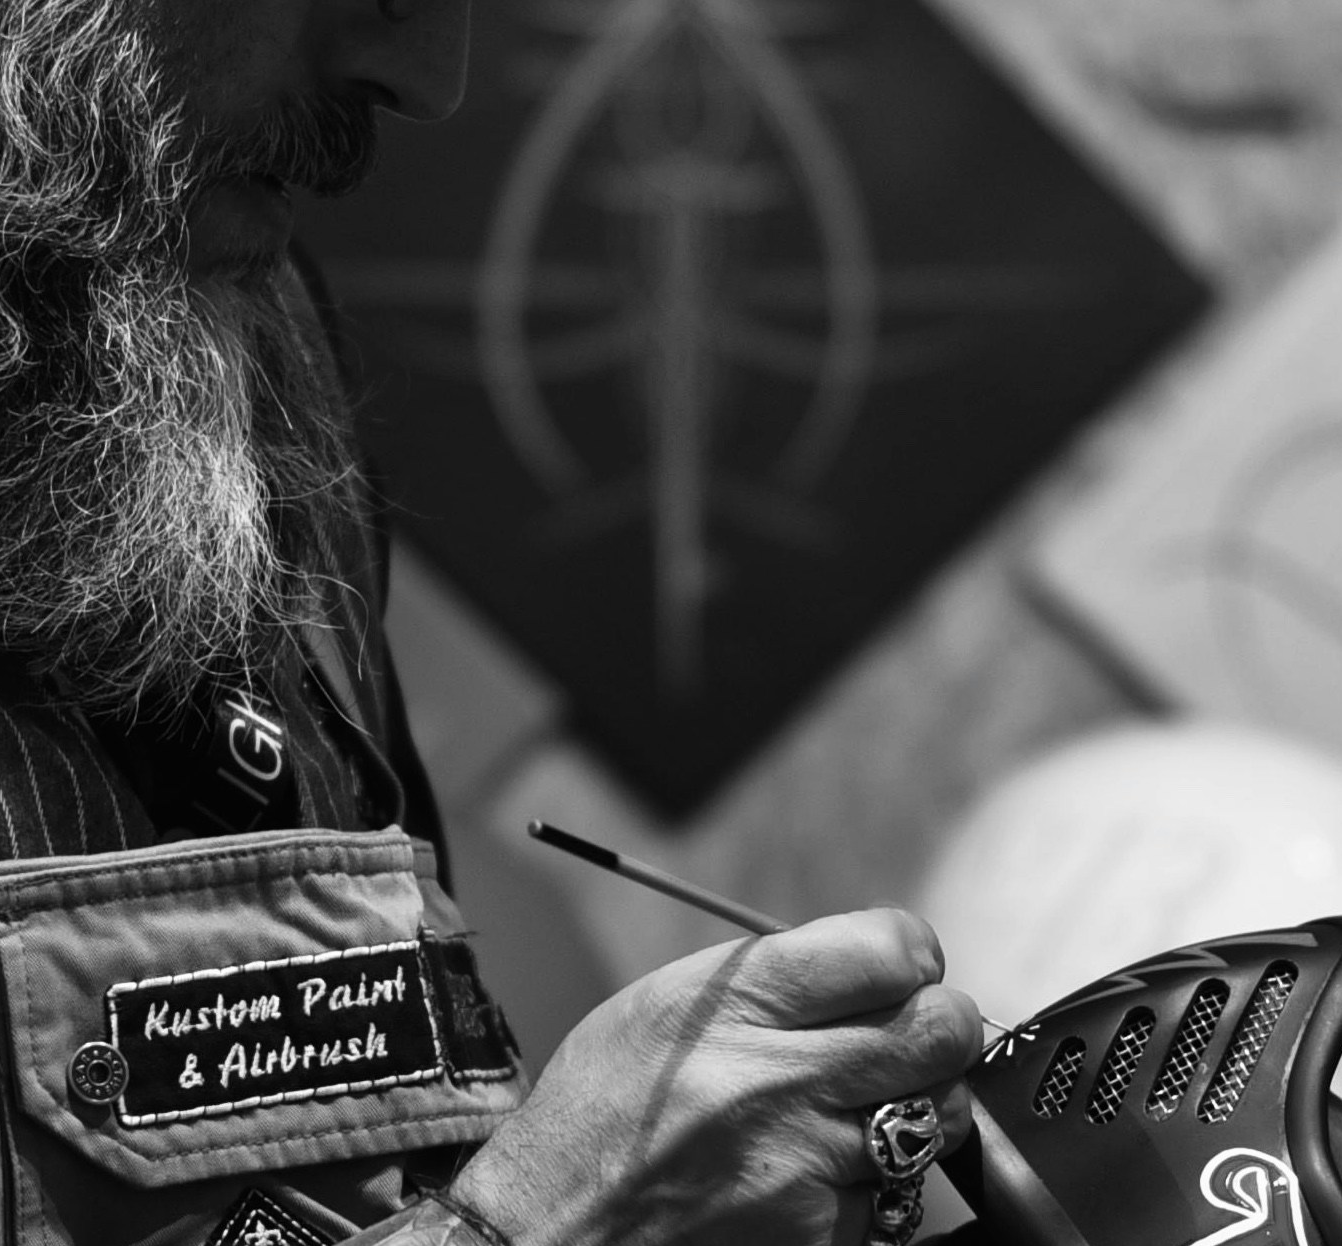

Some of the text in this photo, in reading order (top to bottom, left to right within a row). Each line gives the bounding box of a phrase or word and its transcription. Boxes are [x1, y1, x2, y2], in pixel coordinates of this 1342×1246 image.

[143, 964, 406, 1041] Kustom Paint
[178, 1021, 389, 1090] & Airbrush
